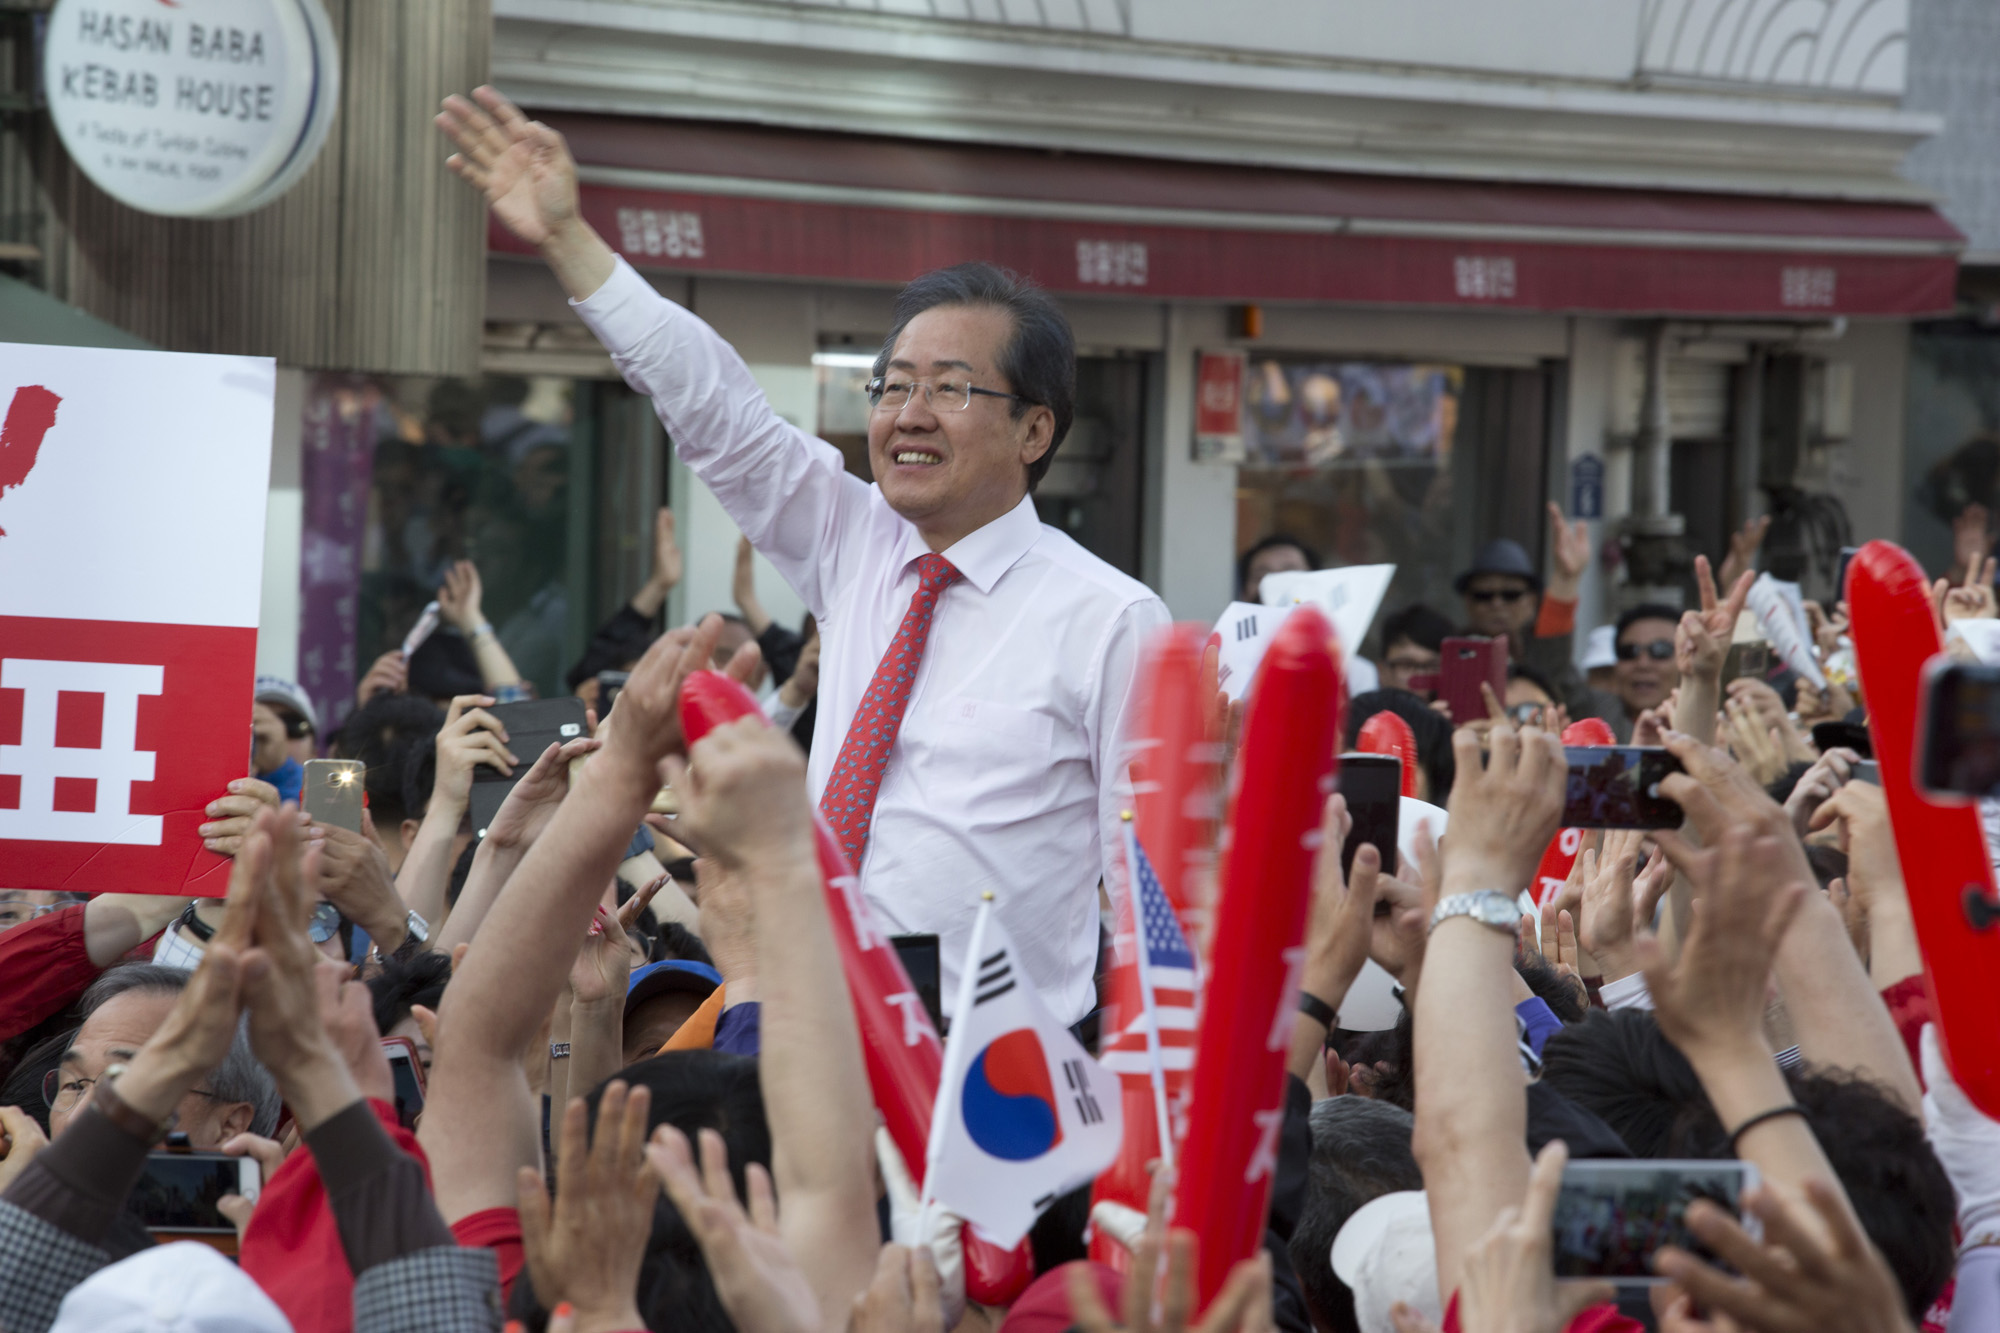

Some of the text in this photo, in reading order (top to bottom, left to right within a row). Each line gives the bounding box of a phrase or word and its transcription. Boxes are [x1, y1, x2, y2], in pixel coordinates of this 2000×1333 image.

[79, 9, 265, 65] HASAN BABA
[61, 64, 274, 122] KEBAB HOUSE
